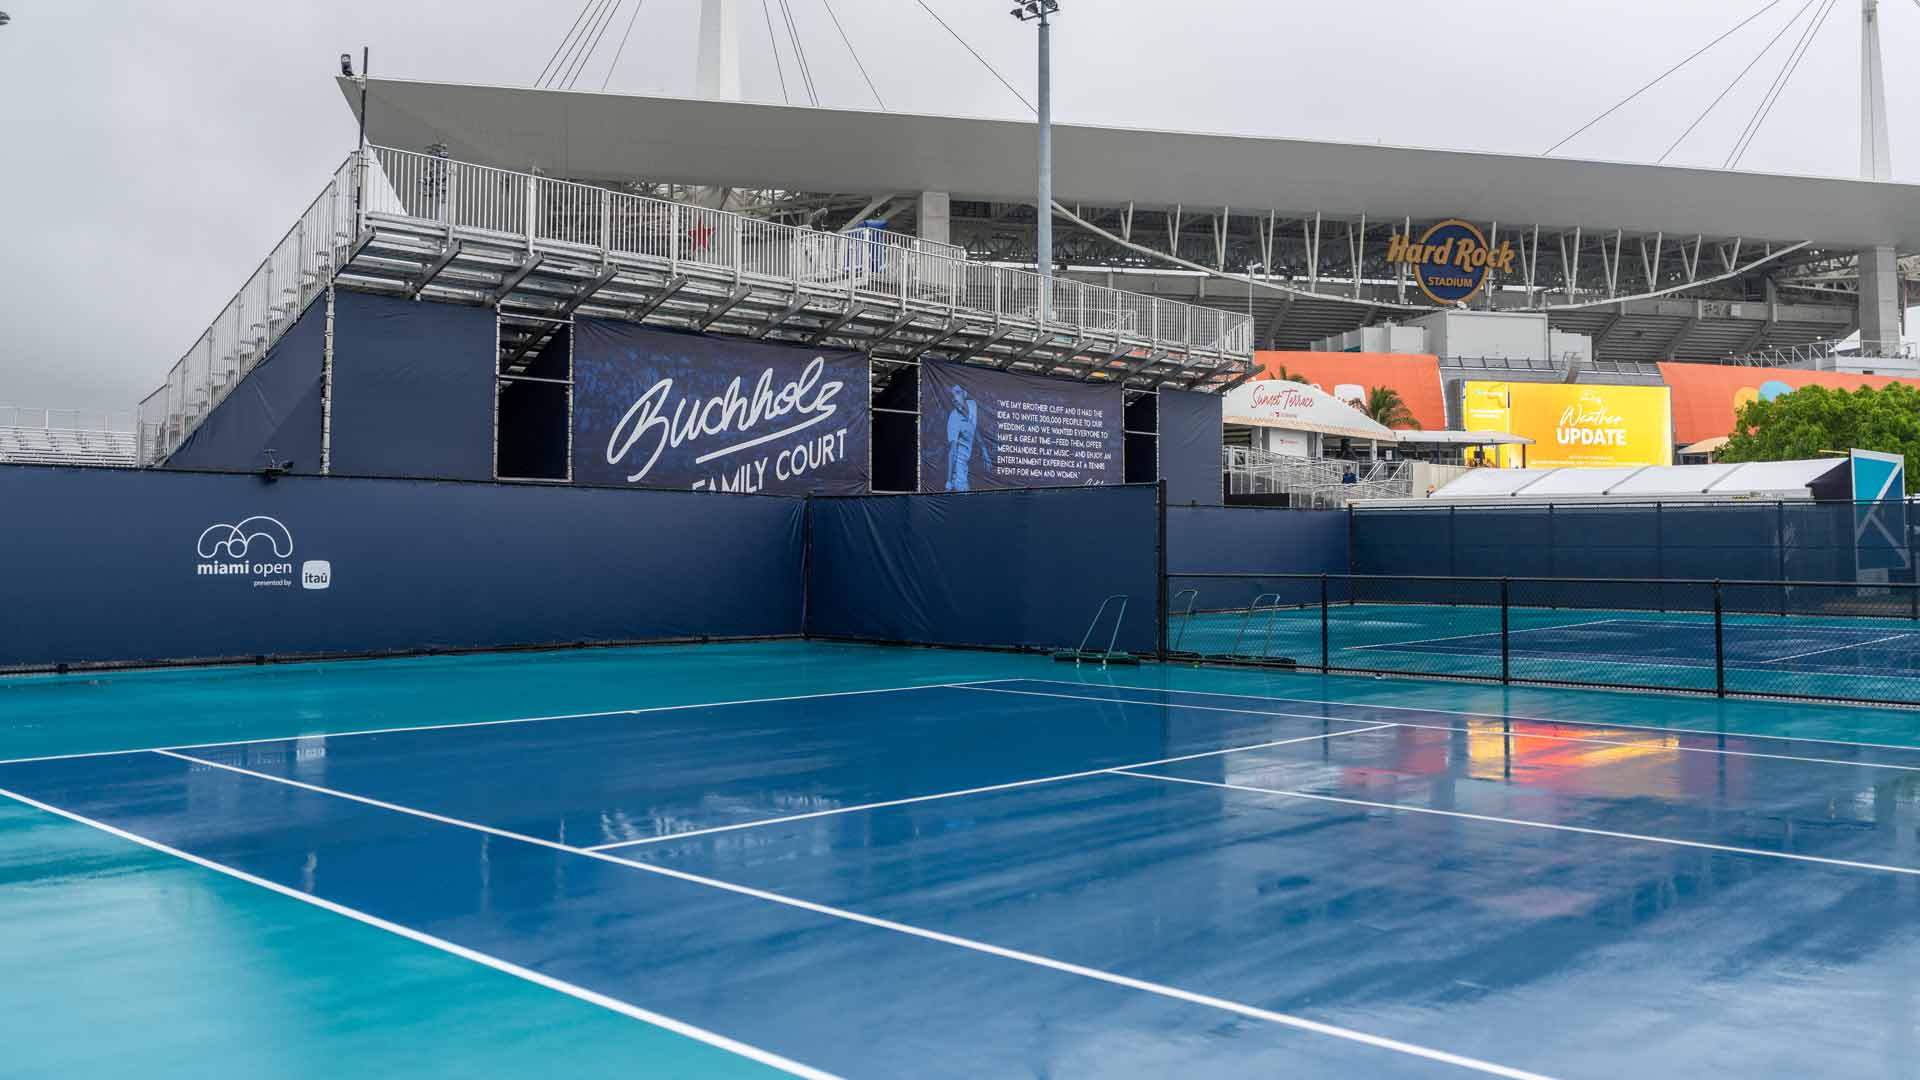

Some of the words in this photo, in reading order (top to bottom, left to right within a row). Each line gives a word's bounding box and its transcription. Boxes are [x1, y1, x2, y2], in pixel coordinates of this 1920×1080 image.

[1386, 232, 1455, 265] Hard
[1455, 237, 1515, 274] Rock
[1427, 276, 1474, 288] STADIUM
[1250, 384, 1281, 409] Sunset
[1280, 388, 1314, 410] Terrace
[1023, 402, 1048, 412] BROTHER
[1065, 407, 1076, 415] AND
[1082, 409, 1093, 417] HAD
[1094, 409, 1104, 418] THE
[1559, 404, 1625, 427] Weather
[606, 356, 844, 482] Buchholz
[997, 410, 1010, 419] IDEA
[1012, 412, 1020, 420] TO
[1021, 413, 1039, 422] INVITE
[1062, 417, 1083, 426] PEOPLE
[1084, 419, 1091, 427] TO
[1092, 420, 1103, 428] OUR
[1028, 424, 1040, 433] AND
[1040, 426, 1050, 434] WE
[1051, 427, 1073, 436] WANTED
[1074, 428, 1101, 438] EVERYONE
[1101, 430, 1109, 439] TO
[1556, 427, 1628, 447] UPDATE
[997, 432, 1013, 442] HAVE
[1019, 435, 1038, 444] GREAT
[1085, 440, 1103, 449] OFFER
[775, 428, 848, 481] COURT
[1039, 447, 1053, 456] PLAY
[1086, 450, 1104, 460] ENJOY
[1103, 452, 1112, 461] AN
[997, 455, 1042, 466] ENTERTAINMENT
[1043, 458, 1075, 468] EXPERIENCE
[1088, 461, 1105, 471] TENNIS
[997, 466, 1016, 475] EVENT
[1016, 468, 1029, 476] FOR
[1030, 469, 1042, 477] MEN
[1043, 469, 1055, 478] AND
[197, 560, 249, 575] miami
[253, 563, 292, 577] open
[253, 579, 283, 588] presented
[284, 579, 292, 587] by
[304, 572, 328, 584] itaú
